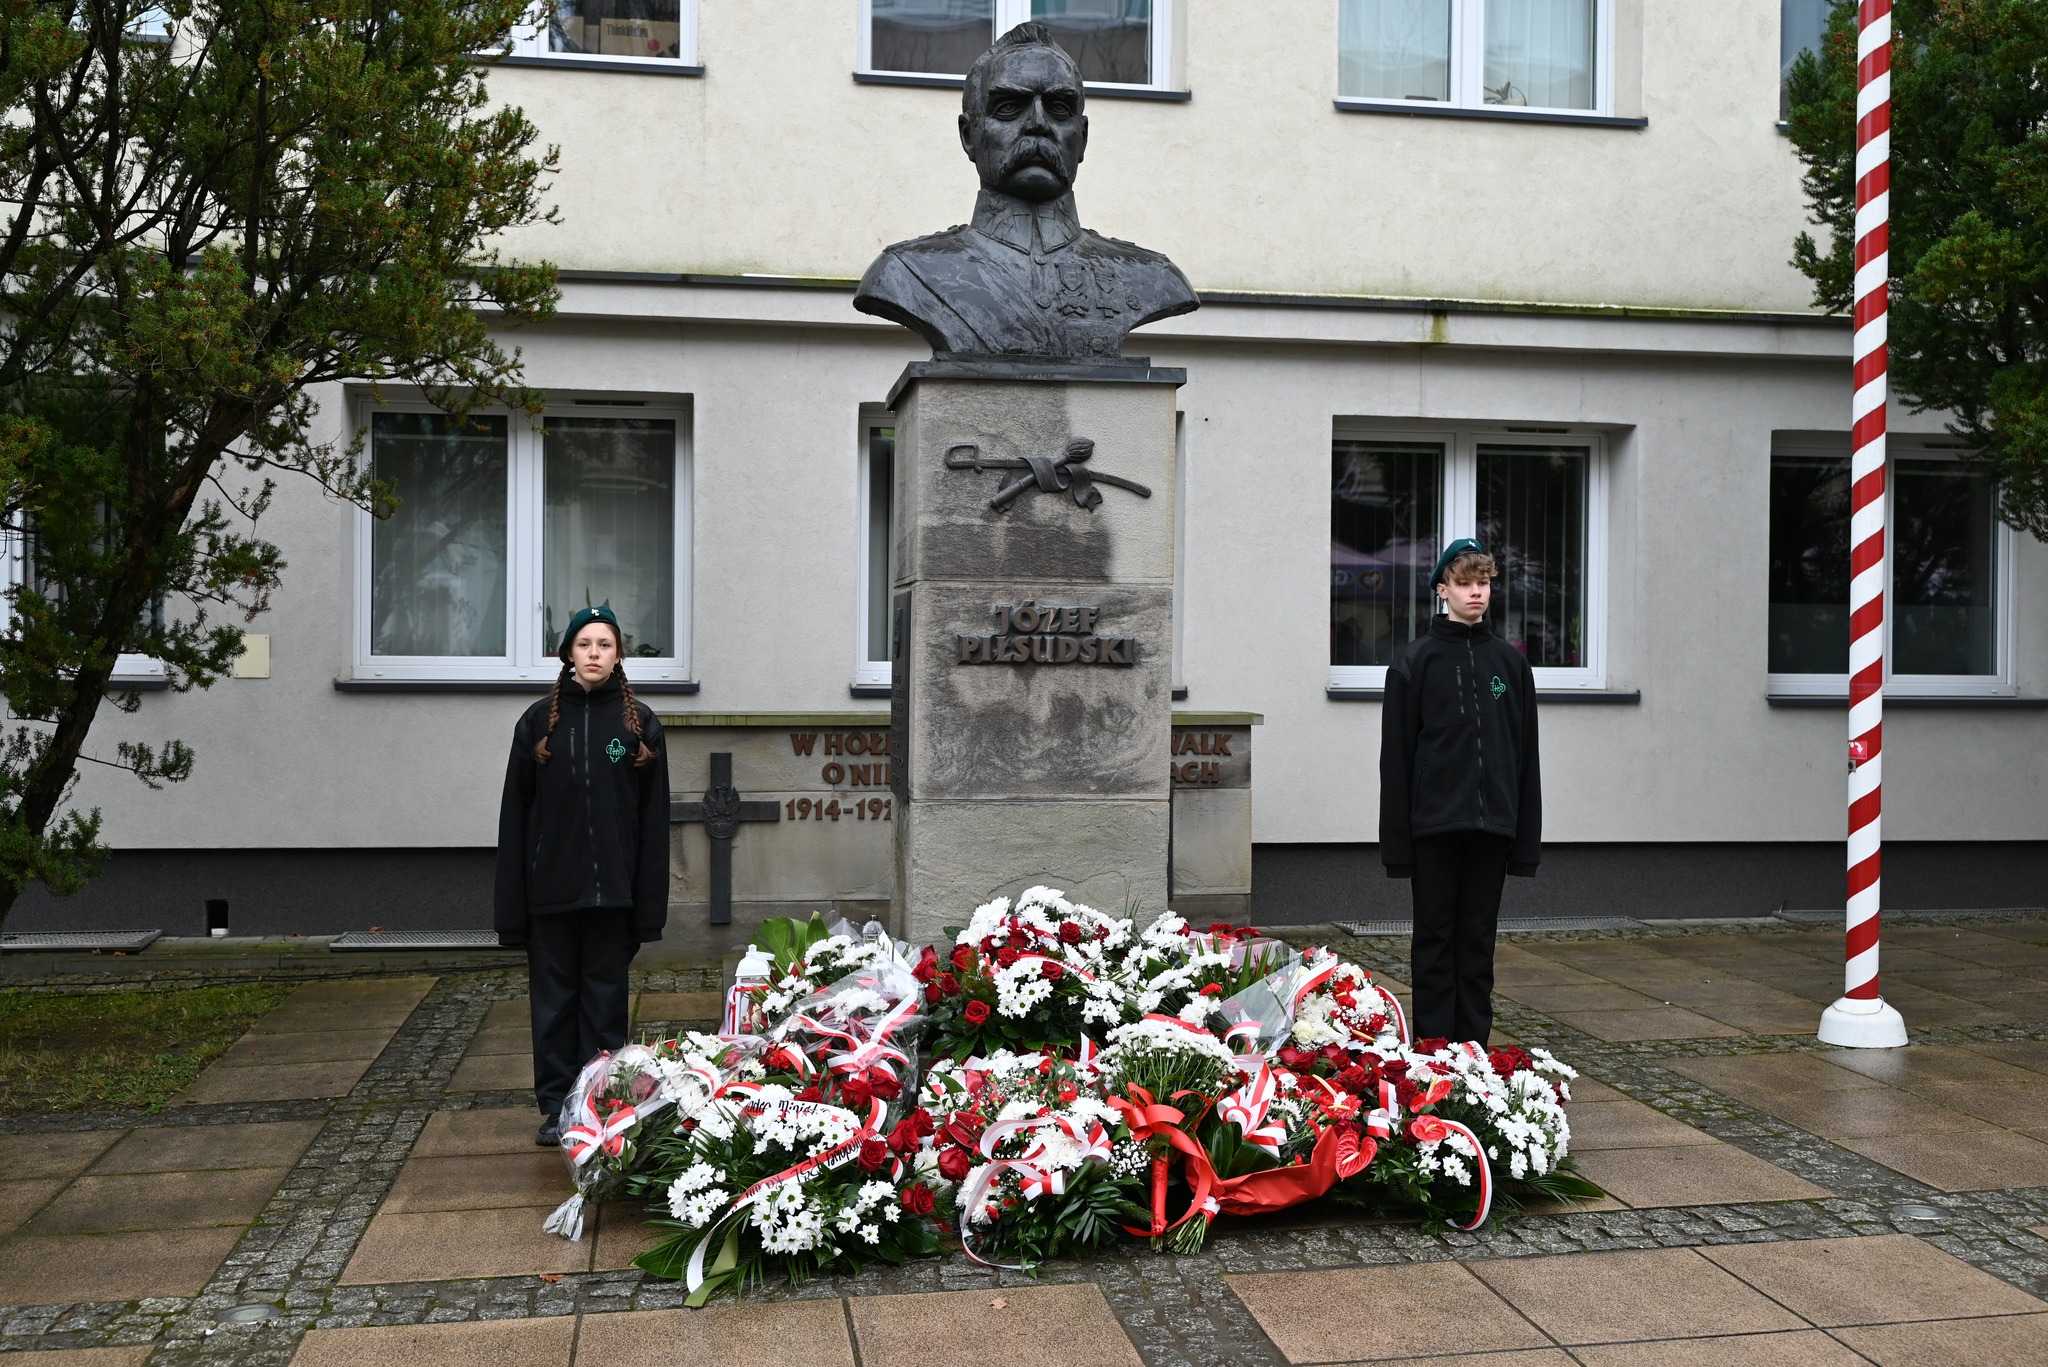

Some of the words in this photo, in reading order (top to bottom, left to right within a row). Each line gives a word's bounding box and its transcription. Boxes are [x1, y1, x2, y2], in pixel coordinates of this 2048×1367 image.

[995, 600, 1100, 635] JÓZEF
[957, 634, 1135, 666] PIŁSUDSKI
[790, 733, 818, 756] W
[822, 762, 845, 785] O
